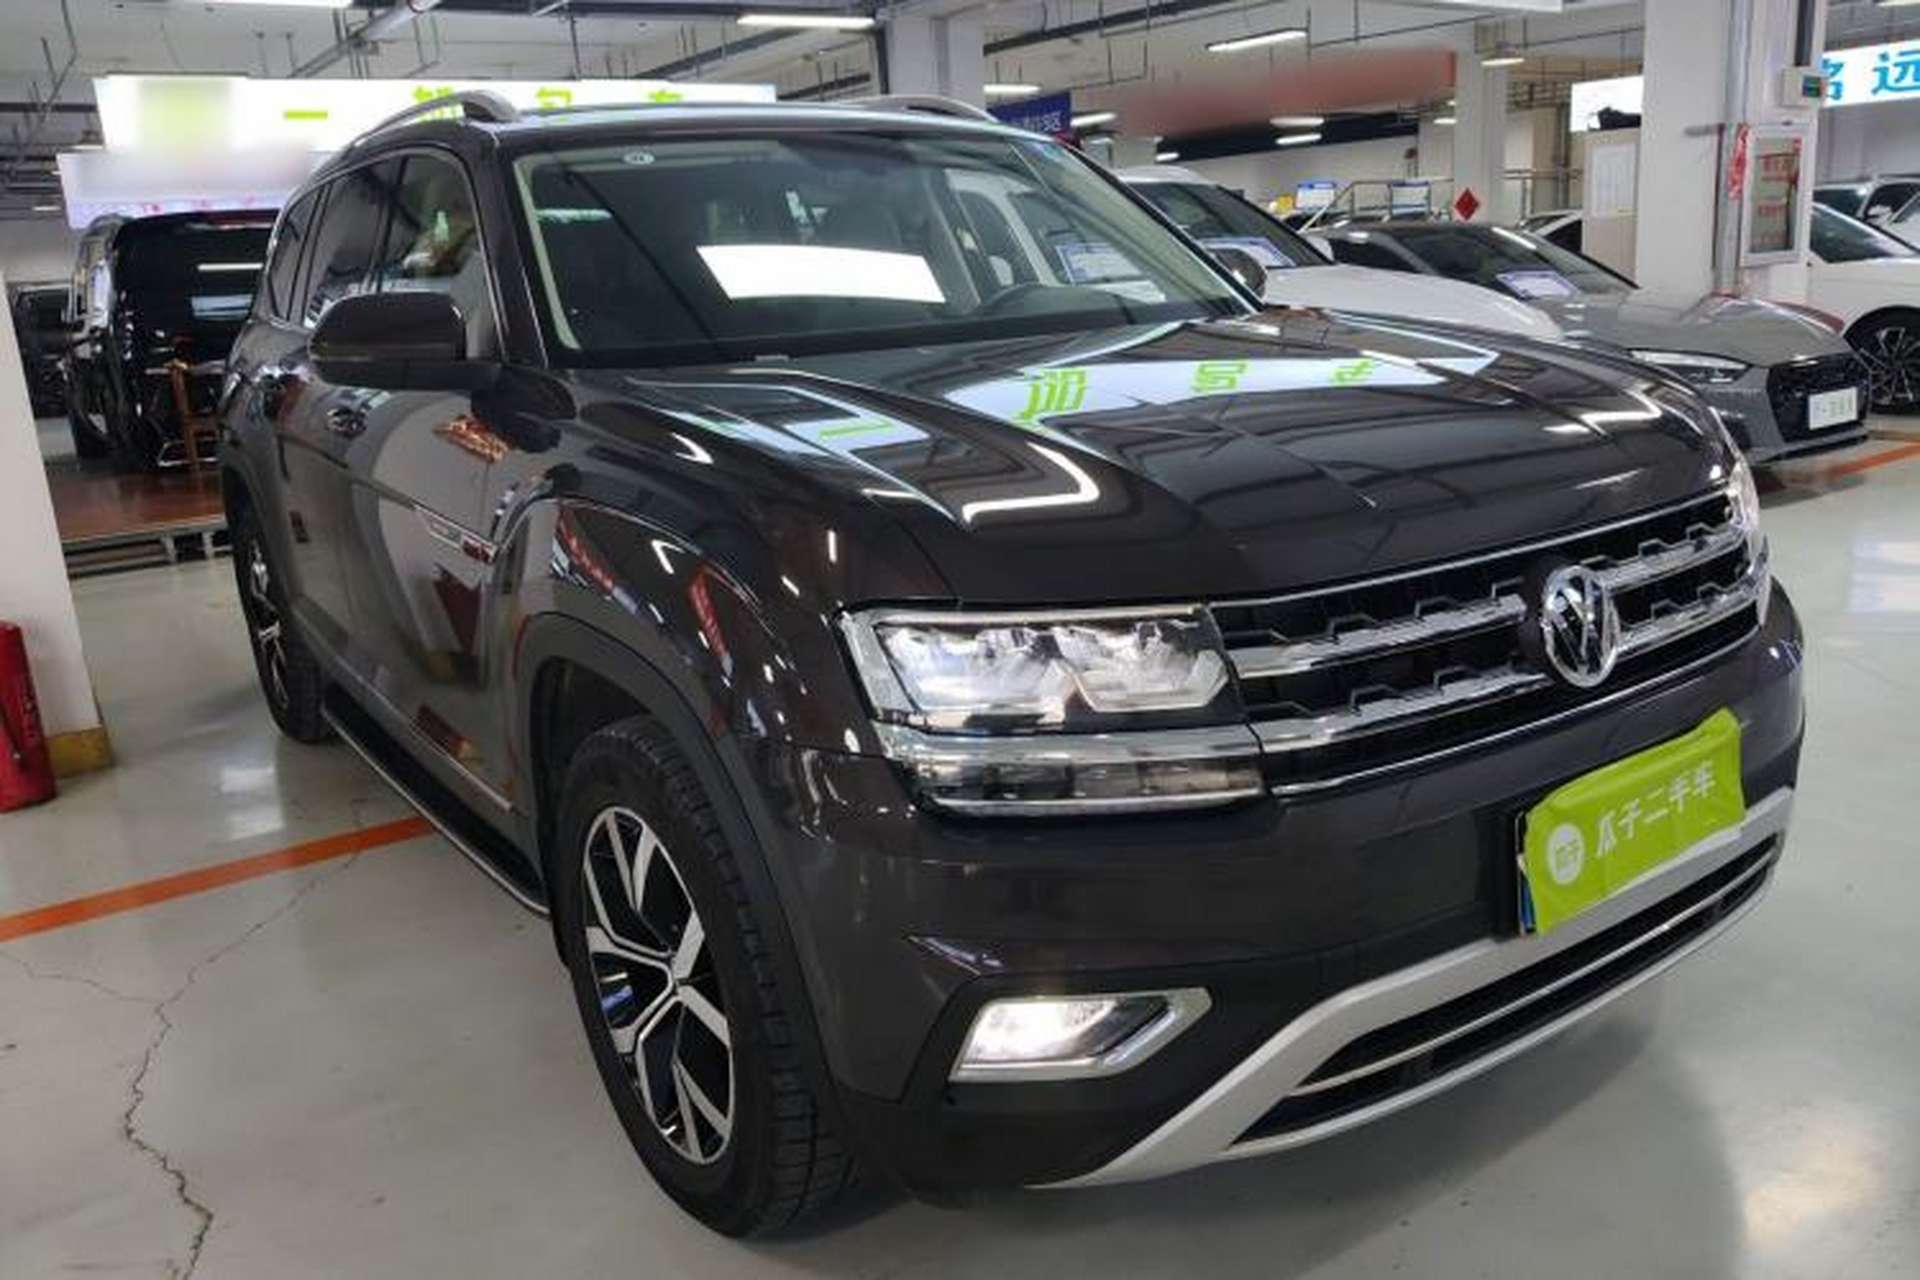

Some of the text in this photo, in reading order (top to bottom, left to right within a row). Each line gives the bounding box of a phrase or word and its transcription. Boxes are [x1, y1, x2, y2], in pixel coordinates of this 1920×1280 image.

[1596, 760, 1716, 859] 瓜子二手车
